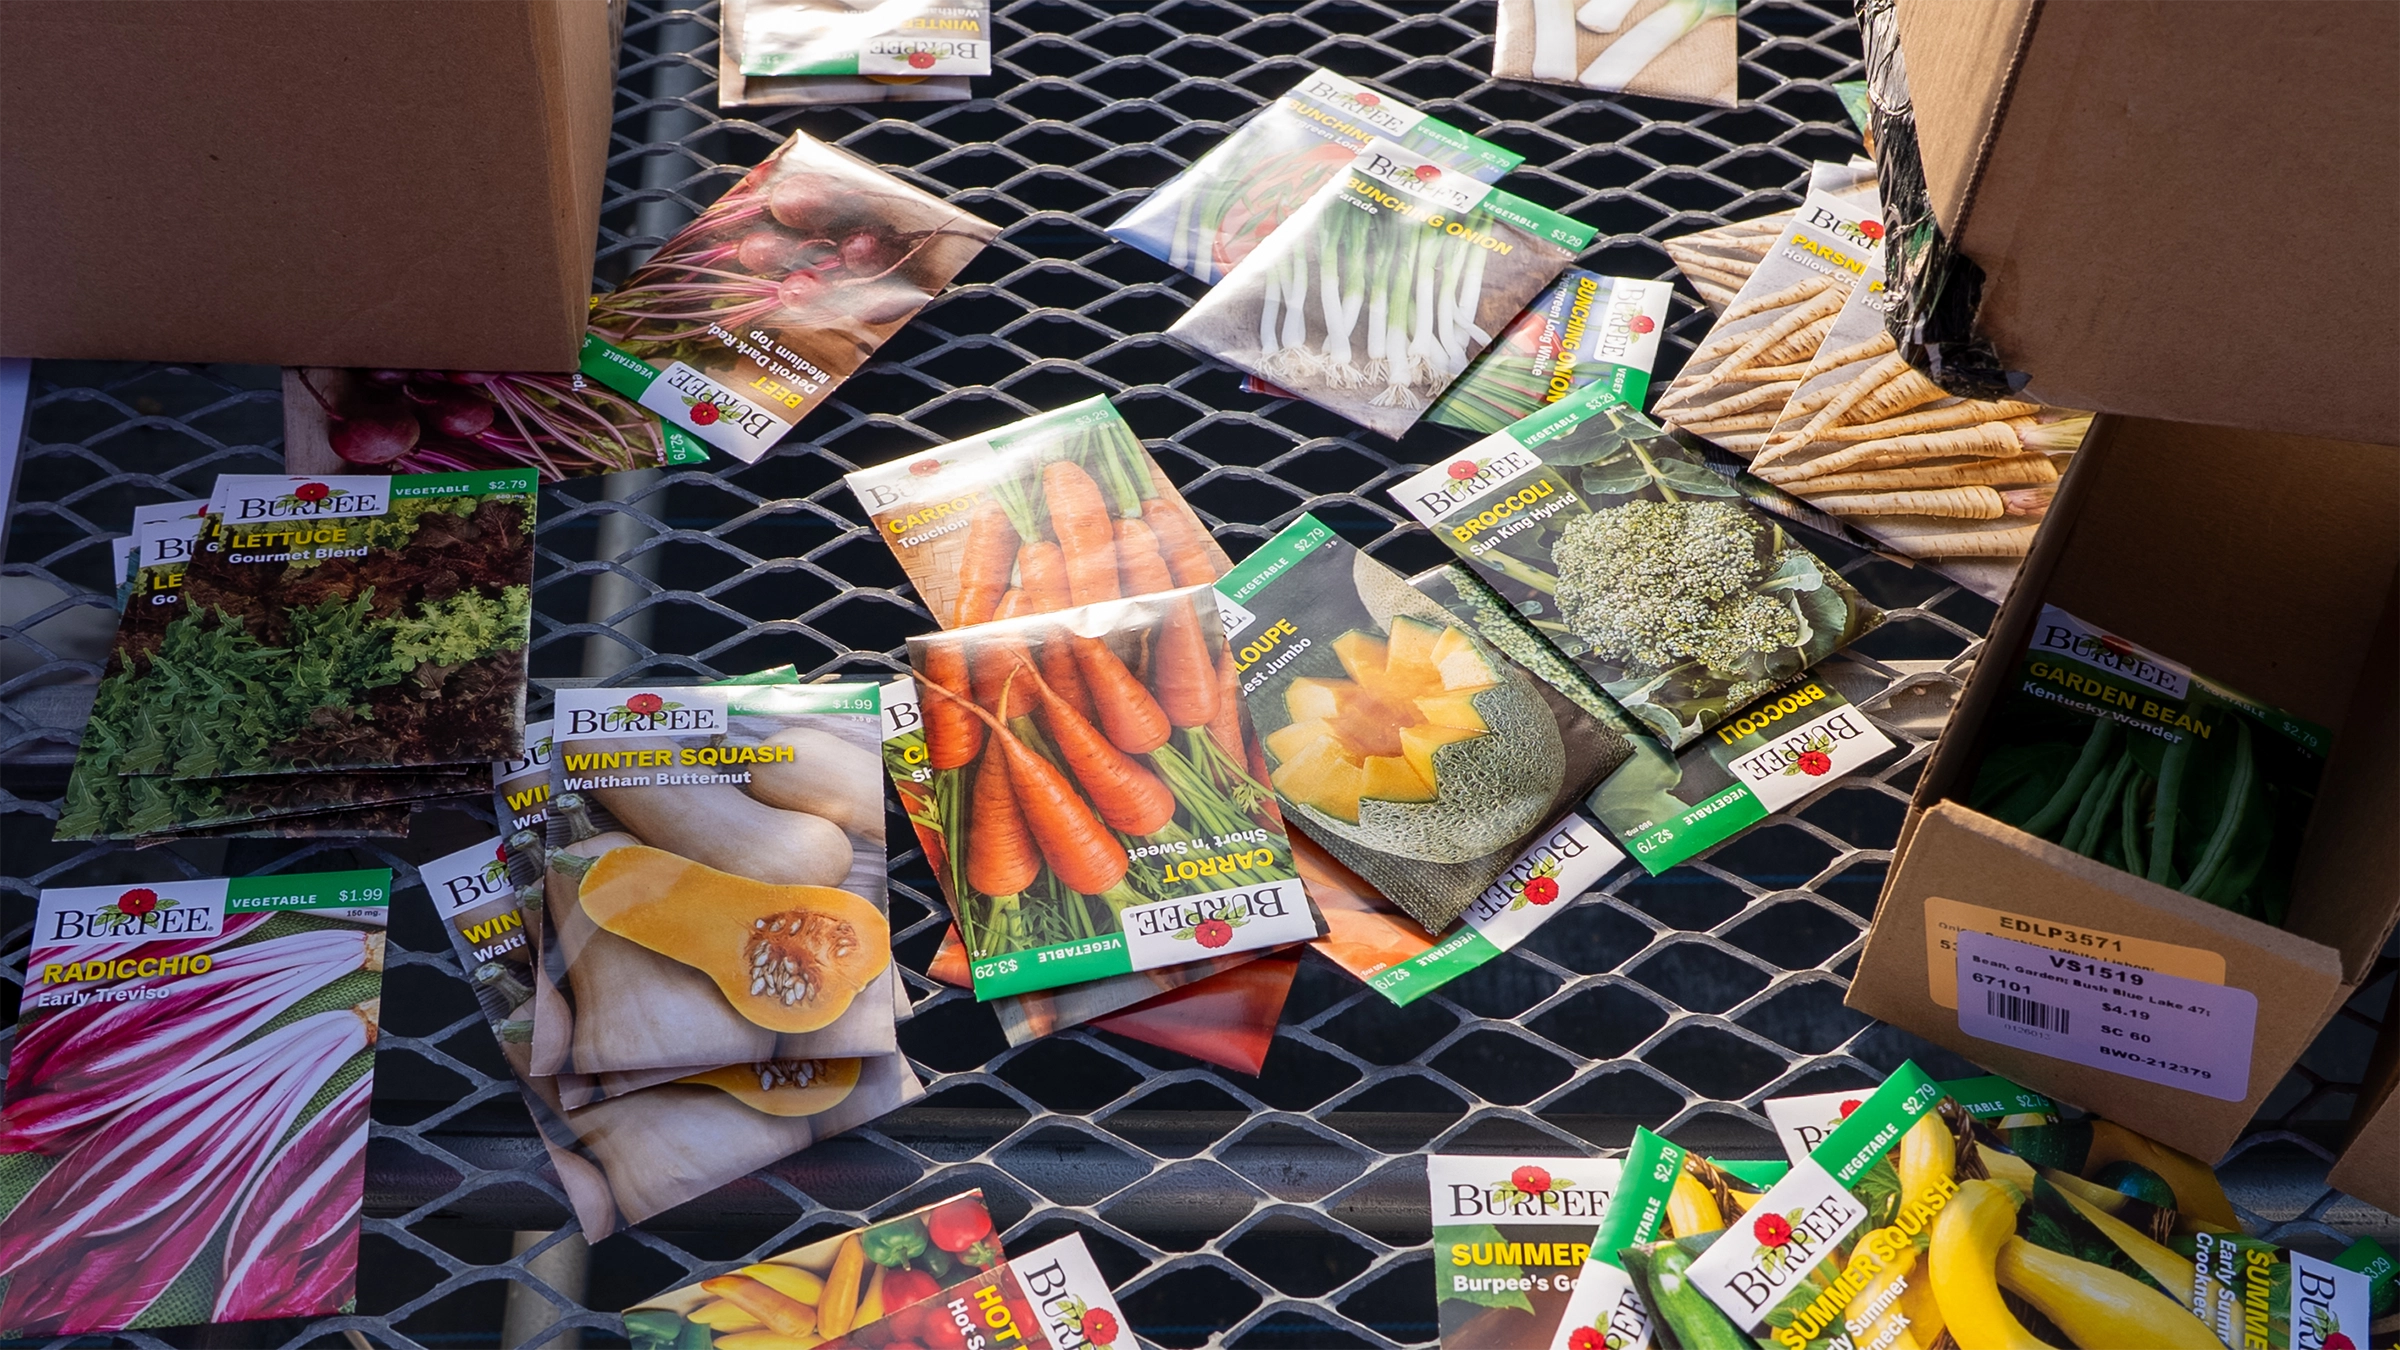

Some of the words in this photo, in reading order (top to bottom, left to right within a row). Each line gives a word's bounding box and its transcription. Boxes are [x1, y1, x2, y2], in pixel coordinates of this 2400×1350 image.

[870, 41, 979, 59] BURPEE
[1306, 81, 1404, 132] BURPEE
[1417, 125, 1470, 151] VEGETABLE
[1480, 151, 1510, 168] $2.79
[1364, 153, 1469, 209] BURPEE
[1346, 177, 1446, 228] BUNCHING
[1445, 222, 1513, 256] ONION
[1483, 201, 1540, 231] VEGETABLE
[1550, 229, 1583, 248] $3.29
[1791, 234, 1866, 275] PARSNI
[1782, 248, 1833, 277] Hollow
[1835, 268, 1857, 288] Cro
[1549, 272, 1575, 319] Evergreen
[1562, 277, 1598, 350] BUNCHING
[1601, 287, 1647, 358] BURPEE
[707, 322, 738, 347] Red,
[750, 330, 774, 351] Top
[1539, 318, 1560, 344] Long
[602, 349, 653, 379] VEGETABLE
[736, 341, 770, 367] Dark
[775, 345, 831, 384] Medium
[1532, 344, 1552, 377] White
[749, 376, 804, 409] BEET
[769, 361, 819, 395] Detroit
[1546, 351, 1577, 404] ONION
[1613, 368, 1627, 394] VEGET
[667, 367, 777, 439] BURPEE
[1075, 410, 1109, 425] $3.29
[1585, 392, 1616, 411] $3.29
[1523, 413, 1579, 446] VEGETABLE
[669, 433, 686, 461] $2.79
[396, 484, 470, 497] VEGETABLE
[488, 479, 527, 490] $2.79
[1416, 451, 1530, 518] BURPEE
[236, 494, 377, 520] BURPEE
[889, 491, 980, 535] CARROT
[1452, 479, 1555, 544] BROCCOLI
[232, 528, 347, 549] LETTUCE
[897, 518, 969, 550] Touchon
[1294, 528, 1326, 552] $2.79
[1469, 534, 1501, 557] Sun
[1497, 515, 1535, 541] King
[1531, 491, 1578, 521] Hybrid
[228, 549, 310, 564] Gourmet
[315, 546, 368, 560] Blend
[1233, 557, 1290, 600] VEGETABLE
[1266, 636, 1312, 675] Jumbo
[2039, 625, 2176, 694] BURPEE
[832, 699, 873, 710] $1.99
[1716, 682, 1827, 745] BROCCOLI
[2022, 680, 2108, 718] Kentucky
[2111, 711, 2183, 745] Wonder
[2029, 661, 2137, 711] GARDEN
[2141, 700, 2212, 739] BEAN
[567, 708, 716, 735] BURPEE
[2282, 721, 2318, 748] $2.79
[564, 749, 673, 772] WINTER
[680, 745, 795, 767] SQUASH
[1742, 712, 1864, 781] BURPEE
[563, 773, 651, 791] Waltham
[656, 770, 752, 786] Butternut
[1683, 787, 1748, 826] VEGETABLE
[1128, 841, 1189, 861] Sweet
[1214, 829, 1268, 847] Short
[1637, 828, 1674, 855] $2.79
[1162, 848, 1275, 884] CARROT
[1470, 827, 1588, 923] BURPEE
[232, 894, 318, 908] VEGETABLE
[339, 888, 383, 903] $1.99
[1136, 887, 1290, 936] BURPEE
[49, 907, 210, 941] BURPEE
[2000, 916, 2123, 952] EDLP3571
[1037, 938, 1121, 963] VEGETABLE
[1415, 932, 1476, 967] VEGETABLE
[43, 954, 213, 984] RADICCHIO
[974, 958, 1018, 979] $3.29
[1375, 968, 1410, 990] $2.79
[1972, 955, 2010, 971] Bean,
[2073, 979, 2108, 993] Bush
[2113, 989, 2144, 1002] Blue
[2149, 996, 2183, 1011] Lake
[1972, 972, 2031, 995] 67101
[2050, 955, 2145, 986] VS1519
[37, 989, 92, 1009] Early
[95, 985, 171, 1002] Treviso
[2102, 1003, 2150, 1021] $4.19
[2101, 1025, 2124, 1037] SC
[2129, 1032, 2151, 1044] 60
[2100, 1046, 2212, 1080] BWO-212379
[1901, 1083, 1936, 1116] $2.79
[2015, 1095, 2049, 1108] $2.79
[1653, 1147, 1679, 1183] $2.79
[1838, 1122, 1899, 1182] VEGETABLE
[1725, 1194, 1853, 1314] BURPEE
[1780, 1254, 1882, 1350] SUMMER
[1870, 1173, 1961, 1262] SQUASH
[2215, 1239, 2237, 1286] Early
[1453, 1275, 1550, 1296] Burpee's
[2193, 1232, 2213, 1320] Crooknec
[947, 1297, 977, 1336] Hot
[973, 1284, 1022, 1343] HOT
[1845, 1274, 1909, 1337] Summer
